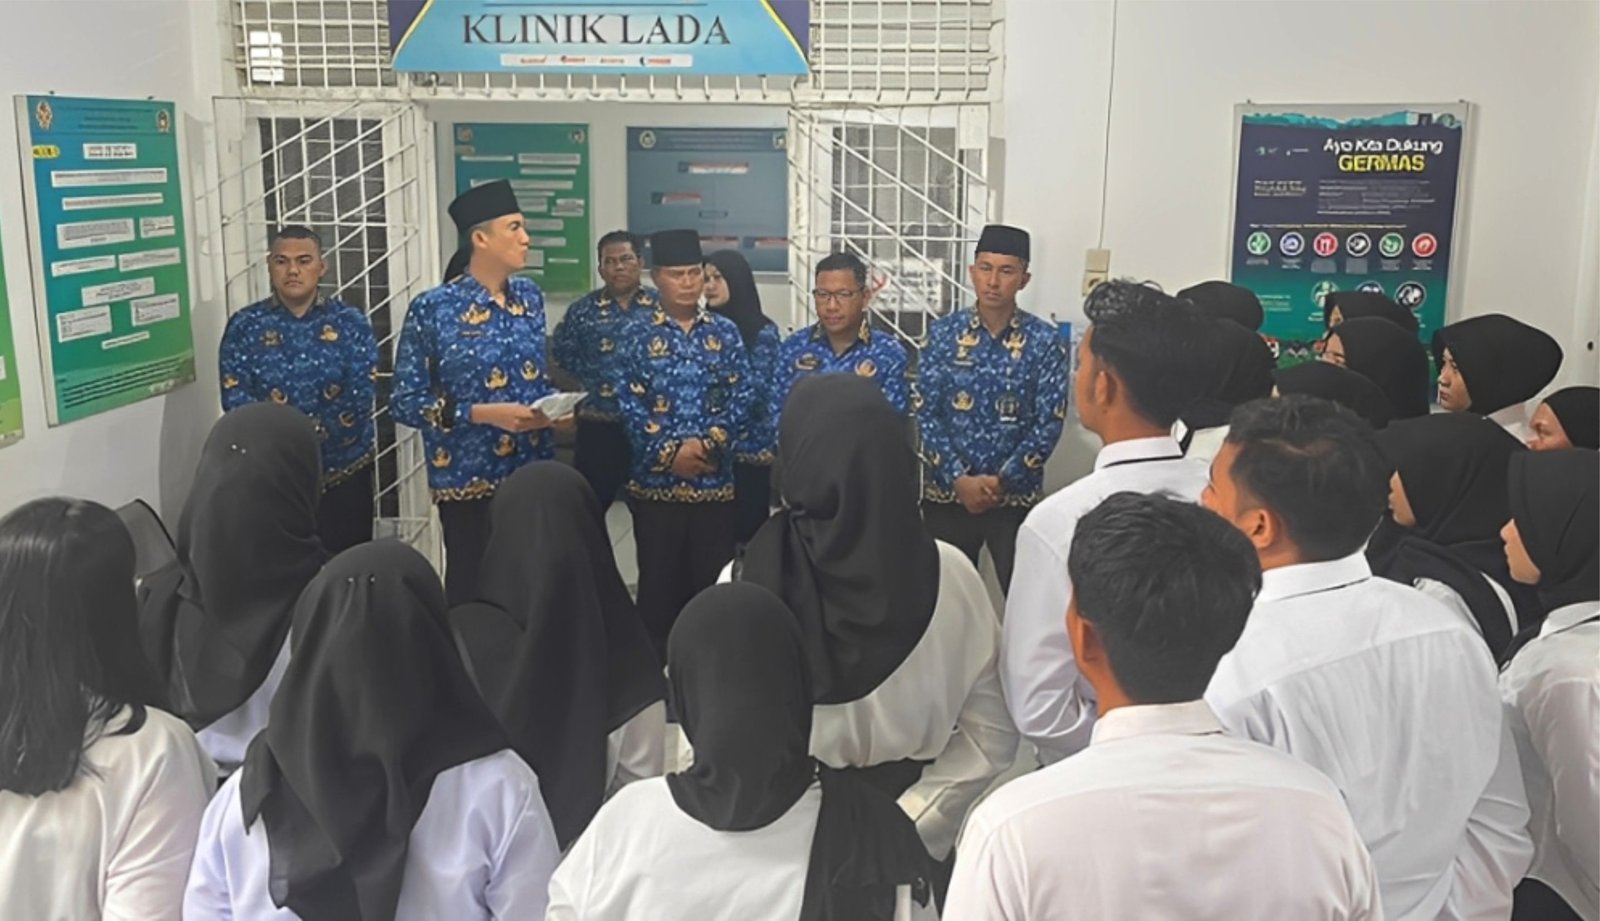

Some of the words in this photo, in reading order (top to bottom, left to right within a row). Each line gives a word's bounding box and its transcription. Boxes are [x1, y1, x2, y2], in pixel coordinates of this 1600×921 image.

[462, 14, 608, 44] KLINIK
[621, 14, 731, 45] LADA
[1338, 154, 1425, 171] GERMAS
